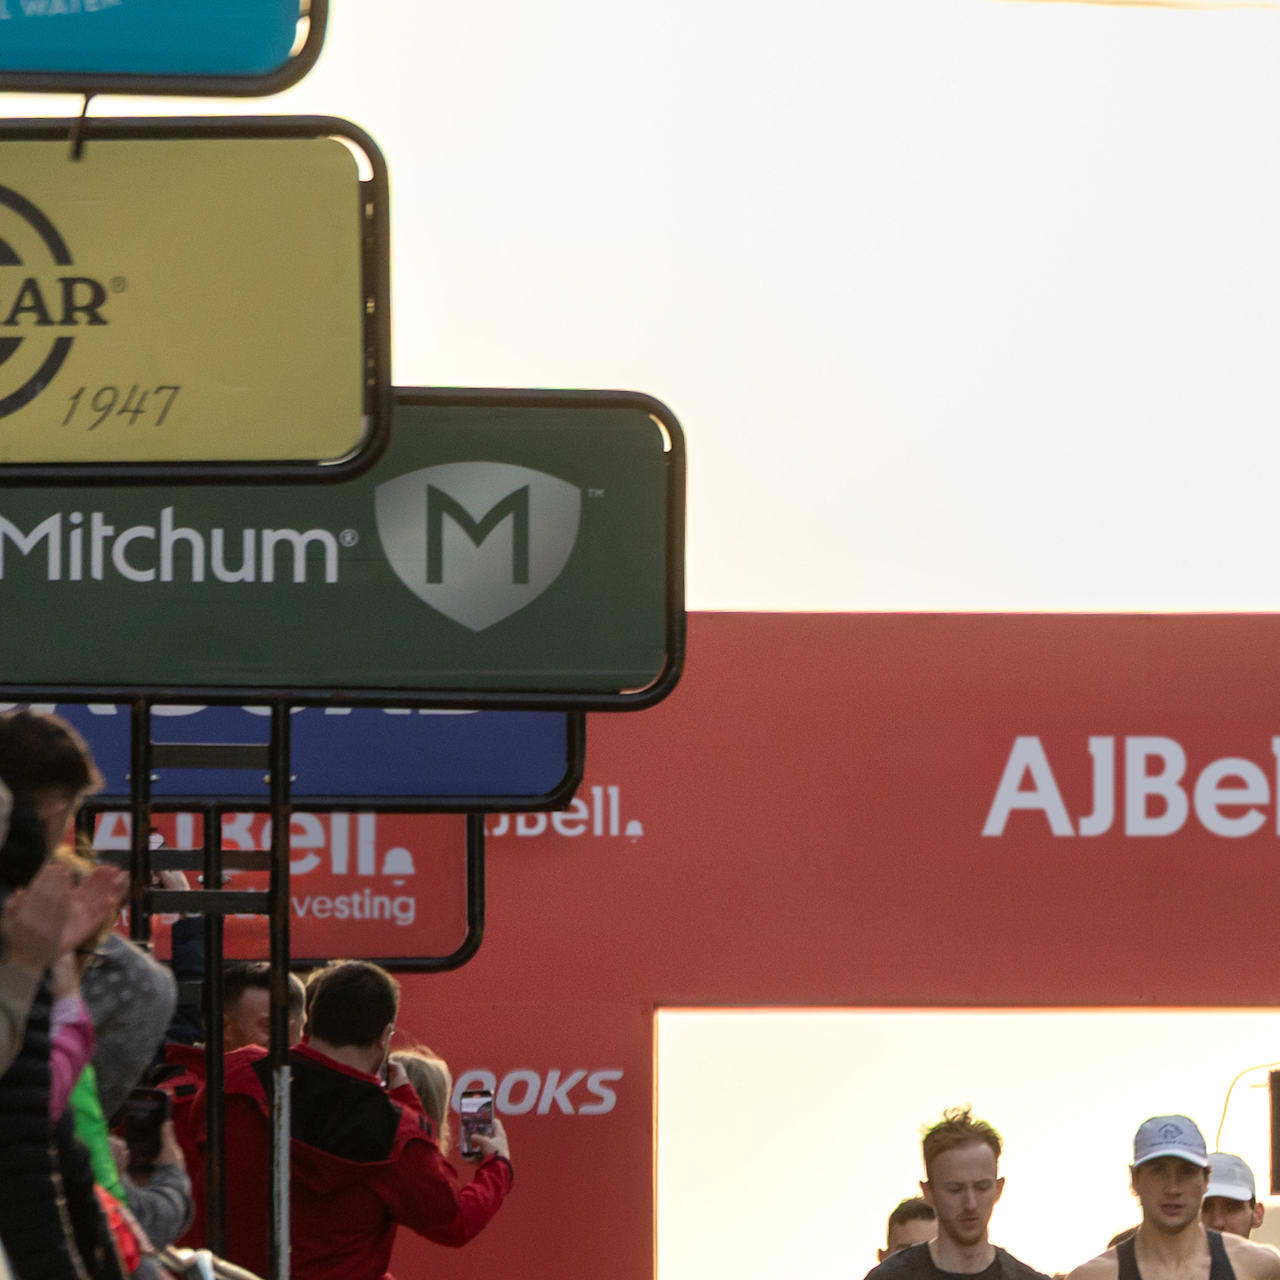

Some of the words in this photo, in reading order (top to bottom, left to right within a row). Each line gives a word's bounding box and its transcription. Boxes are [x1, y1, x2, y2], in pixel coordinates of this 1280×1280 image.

[61, 385, 181, 431] 1947
[0, 507, 339, 584] Mitchum
[450, 1068, 624, 1115] OOKS
